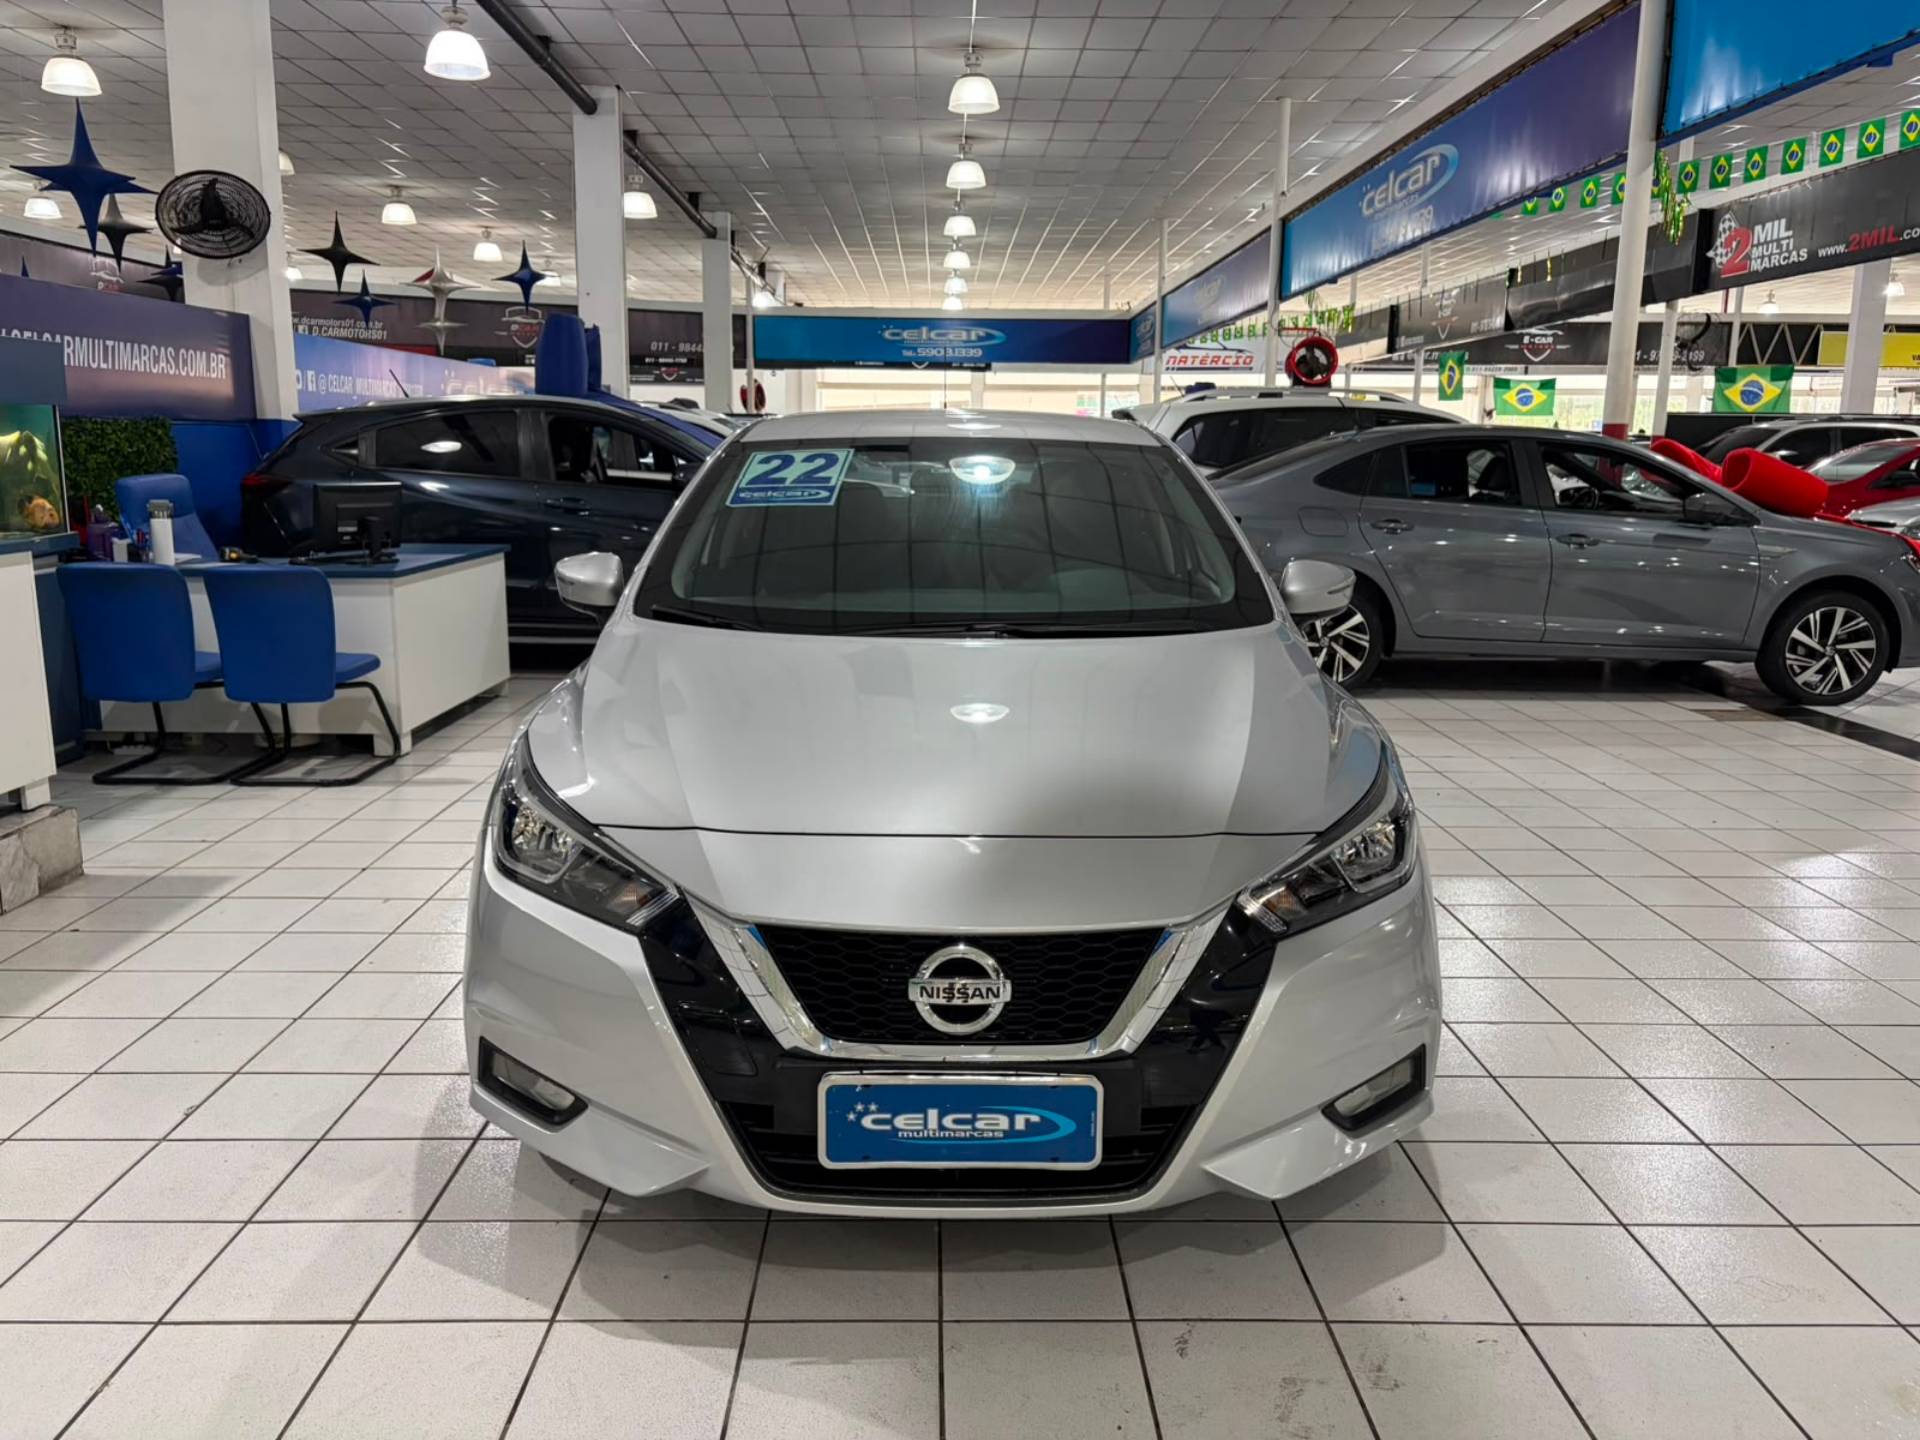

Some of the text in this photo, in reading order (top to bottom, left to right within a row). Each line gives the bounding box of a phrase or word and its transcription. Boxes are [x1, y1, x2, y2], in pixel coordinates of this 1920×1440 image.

[1362, 155, 1441, 218] celcar
[1720, 218, 1793, 278] 2 MIL
[1752, 238, 1795, 258] MULTI
[1750, 248, 1808, 273] MARCAS
[883, 326, 987, 341] celcar
[745, 453, 840, 486] 22
[919, 983, 1001, 1001] NISSAN
[861, 1108, 1042, 1132] celcar
[898, 1129, 1005, 1139] multimarcas
